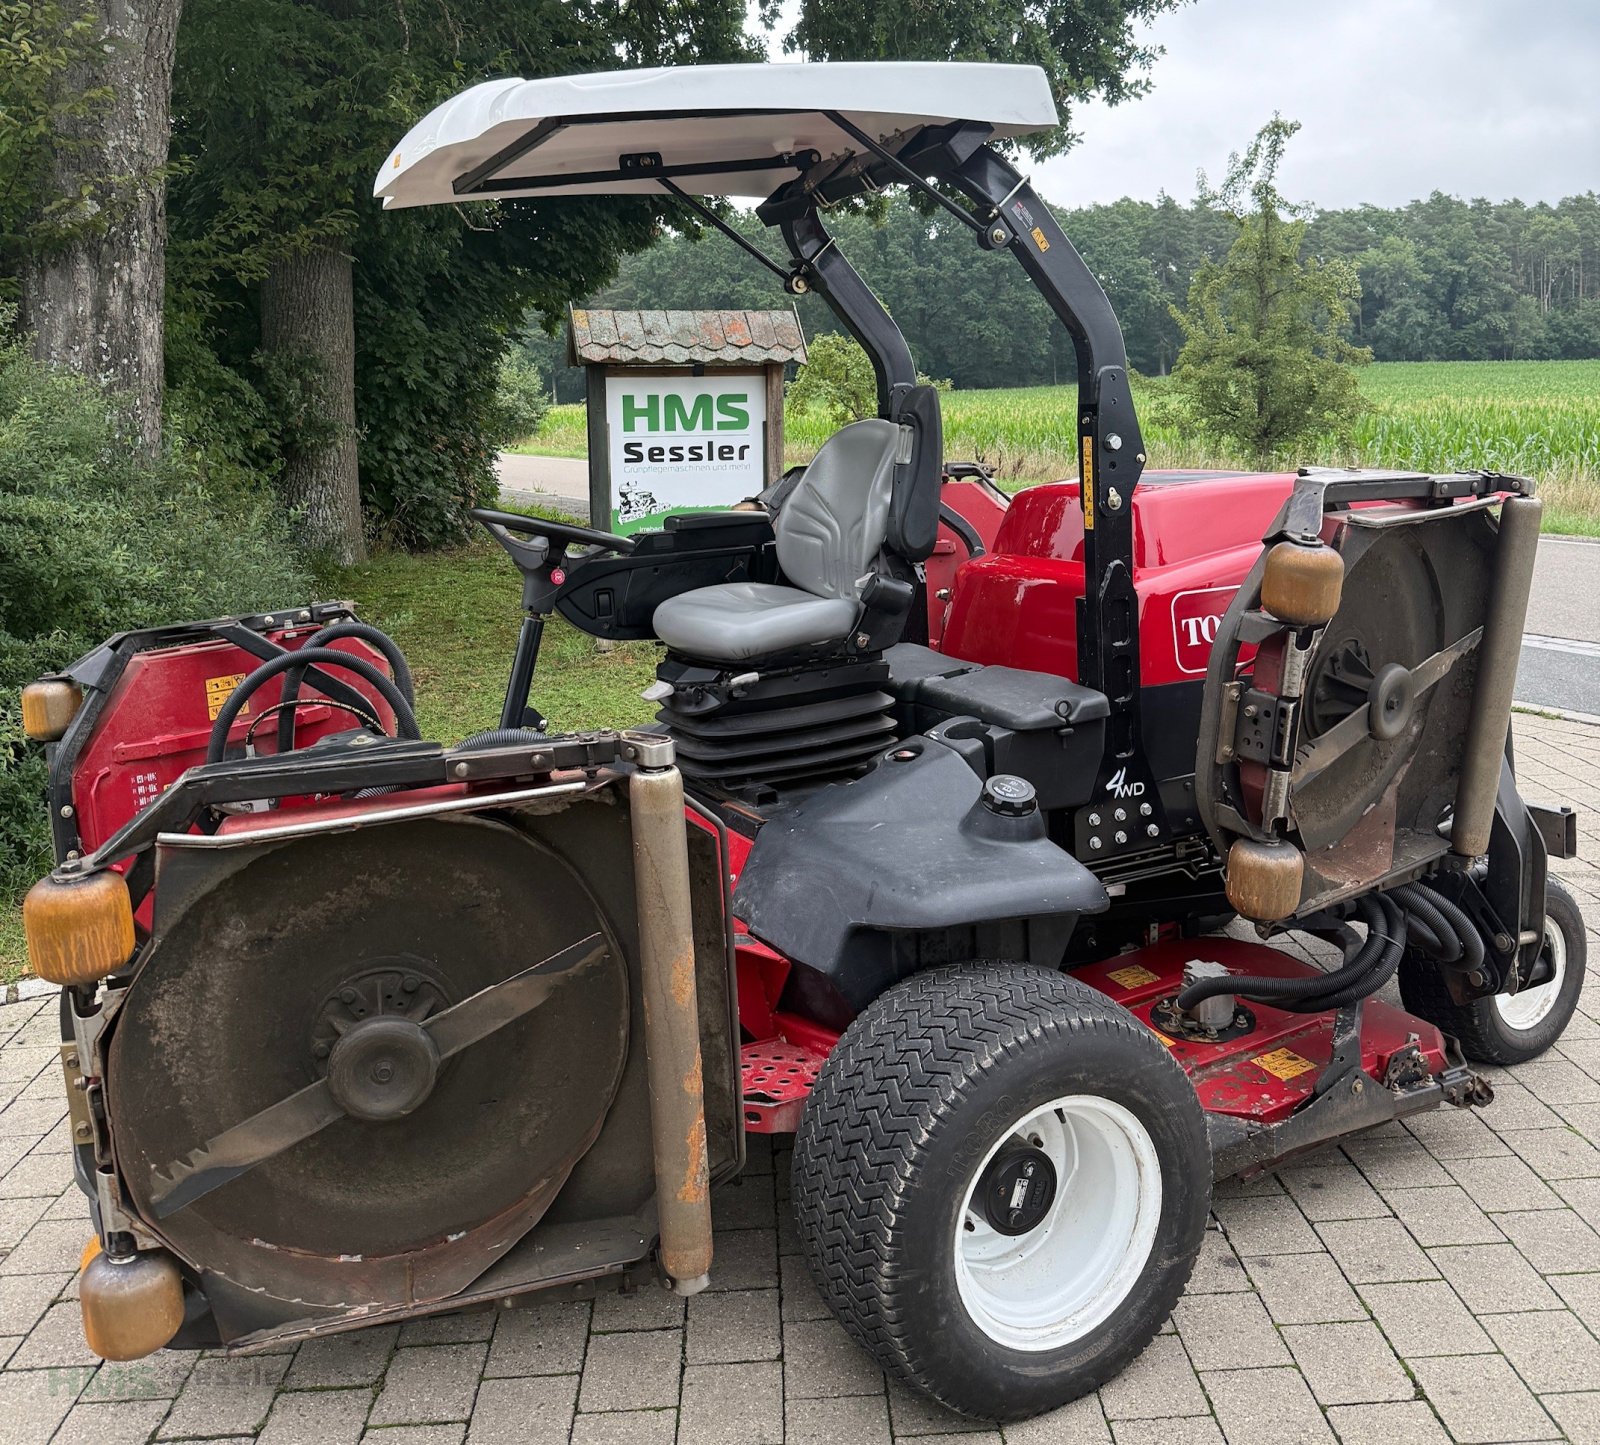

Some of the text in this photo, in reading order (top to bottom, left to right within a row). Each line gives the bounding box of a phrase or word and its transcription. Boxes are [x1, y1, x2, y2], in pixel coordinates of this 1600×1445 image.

[622, 393, 750, 432] HMS
[623, 462, 751, 474] Grünpflegemaschinen und mehr!
[624, 441, 750, 463] Sessler
[1181, 613, 1226, 647] TO
[1105, 766, 1145, 799] 4WD
[945, 1094, 1016, 1177] TORO
